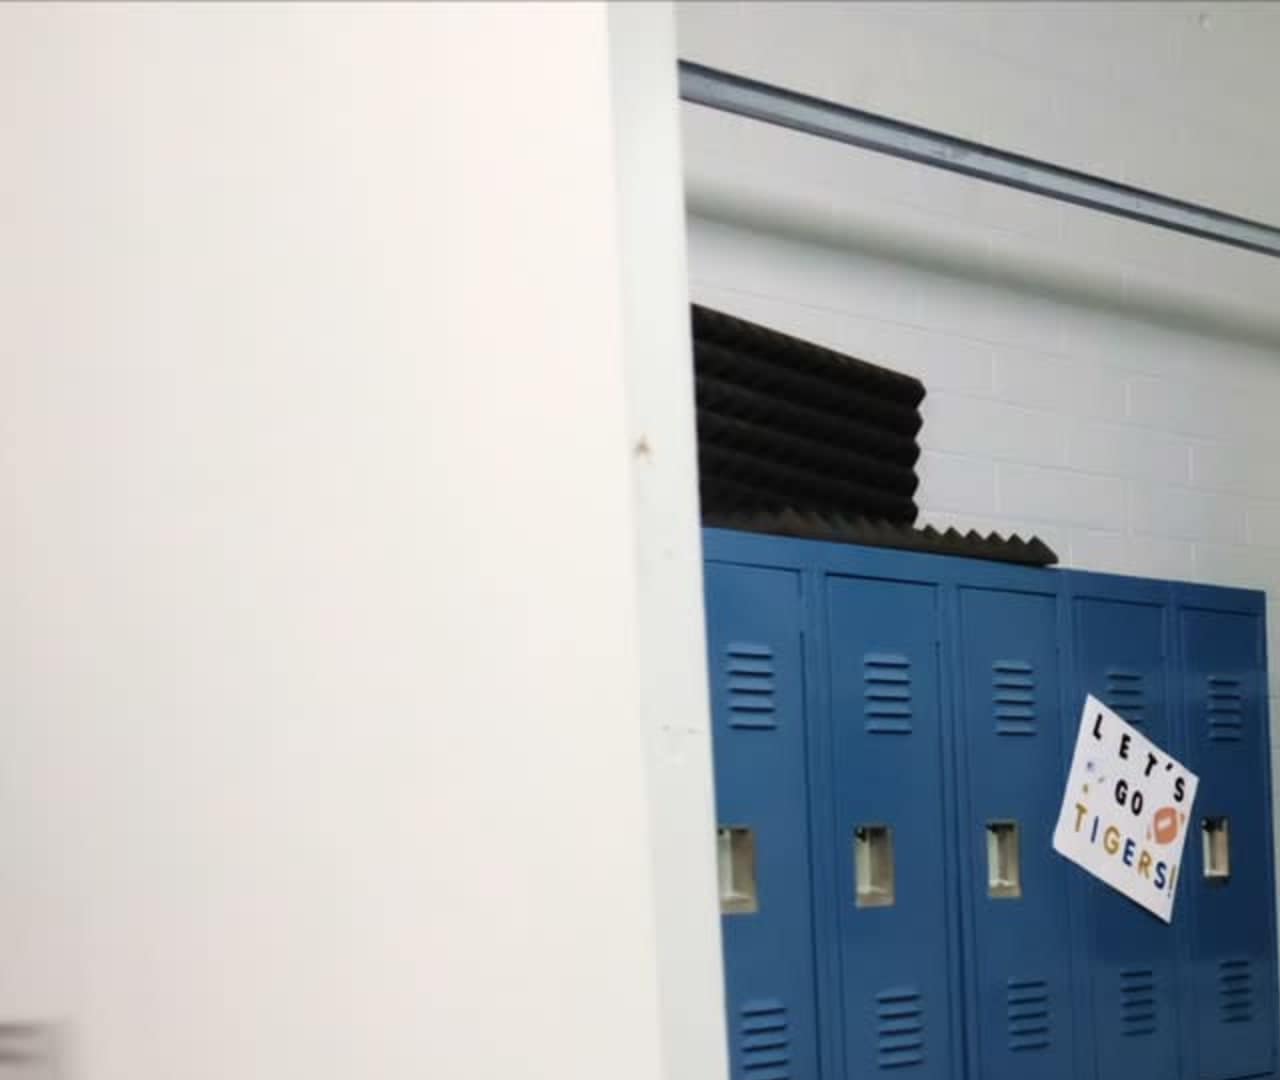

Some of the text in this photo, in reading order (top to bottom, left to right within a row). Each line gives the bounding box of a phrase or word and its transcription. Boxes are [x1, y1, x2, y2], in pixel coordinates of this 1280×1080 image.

[1092, 714, 1186, 803] LET'S
[1114, 779, 1144, 816] GO
[1074, 803, 1177, 898] TIGERS!
